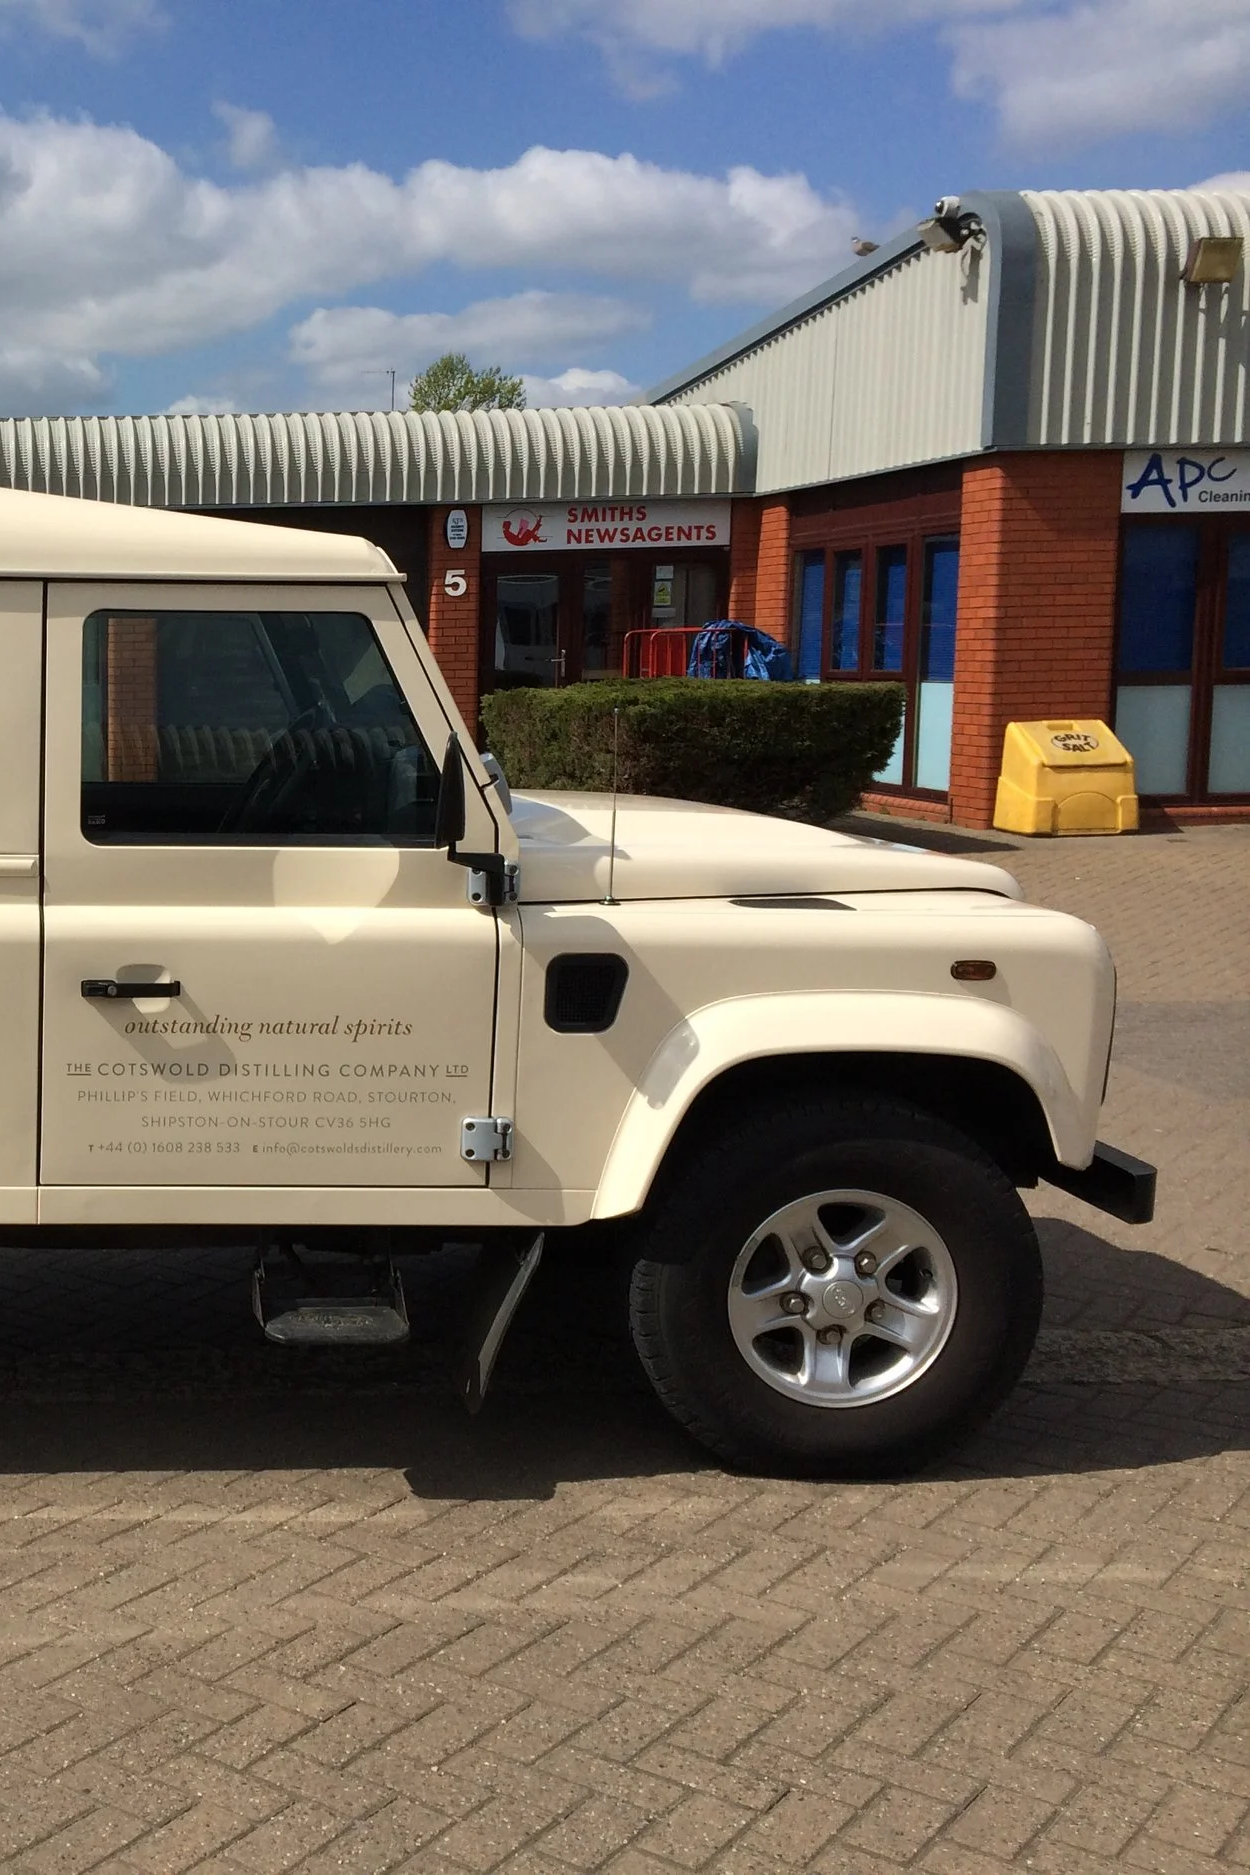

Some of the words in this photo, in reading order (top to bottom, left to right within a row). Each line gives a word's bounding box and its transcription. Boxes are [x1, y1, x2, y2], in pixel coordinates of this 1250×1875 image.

[1126, 453, 1237, 508] APC
[567, 505, 647, 523] SMITHS
[567, 525, 717, 544] NEWSAGENTS
[444, 570, 467, 597] 5
[1054, 734, 1091, 742] GRIT
[1062, 742, 1095, 752] SALT
[124, 1015, 253, 1042] outstanding
[259, 1016, 339, 1035] natural
[344, 1018, 413, 1043] spirits
[66, 1063, 92, 1076] THE
[97, 1063, 209, 1077] COTSWOLD
[219, 1063, 330, 1078] DISTILLING
[339, 1064, 440, 1078] COMPANY
[446, 1065, 469, 1078] LTD
[77, 1090, 148, 1102] PHILLIP'S
[154, 1090, 202, 1103] FIELD,
[207, 1091, 307, 1104] WHICHFORD
[313, 1091, 362, 1104] ROAD,
[368, 1091, 456, 1104] STOURTON,
[141, 1116, 309, 1128] SHIPSTON-ON-STOUR
[315, 1116, 354, 1128] CV36
[359, 1116, 391, 1129] 5HG
[88, 1143, 94, 1152] T
[97, 1141, 123, 1153] +44
[127, 1141, 147, 1155] (0)
[152, 1141, 183, 1153] 1608
[187, 1141, 212, 1153] 238
[216, 1141, 240, 1153] 533
[252, 1144, 258, 1153] E
[262, 1142, 442, 1157] info@cotswoldsdistillery.com
